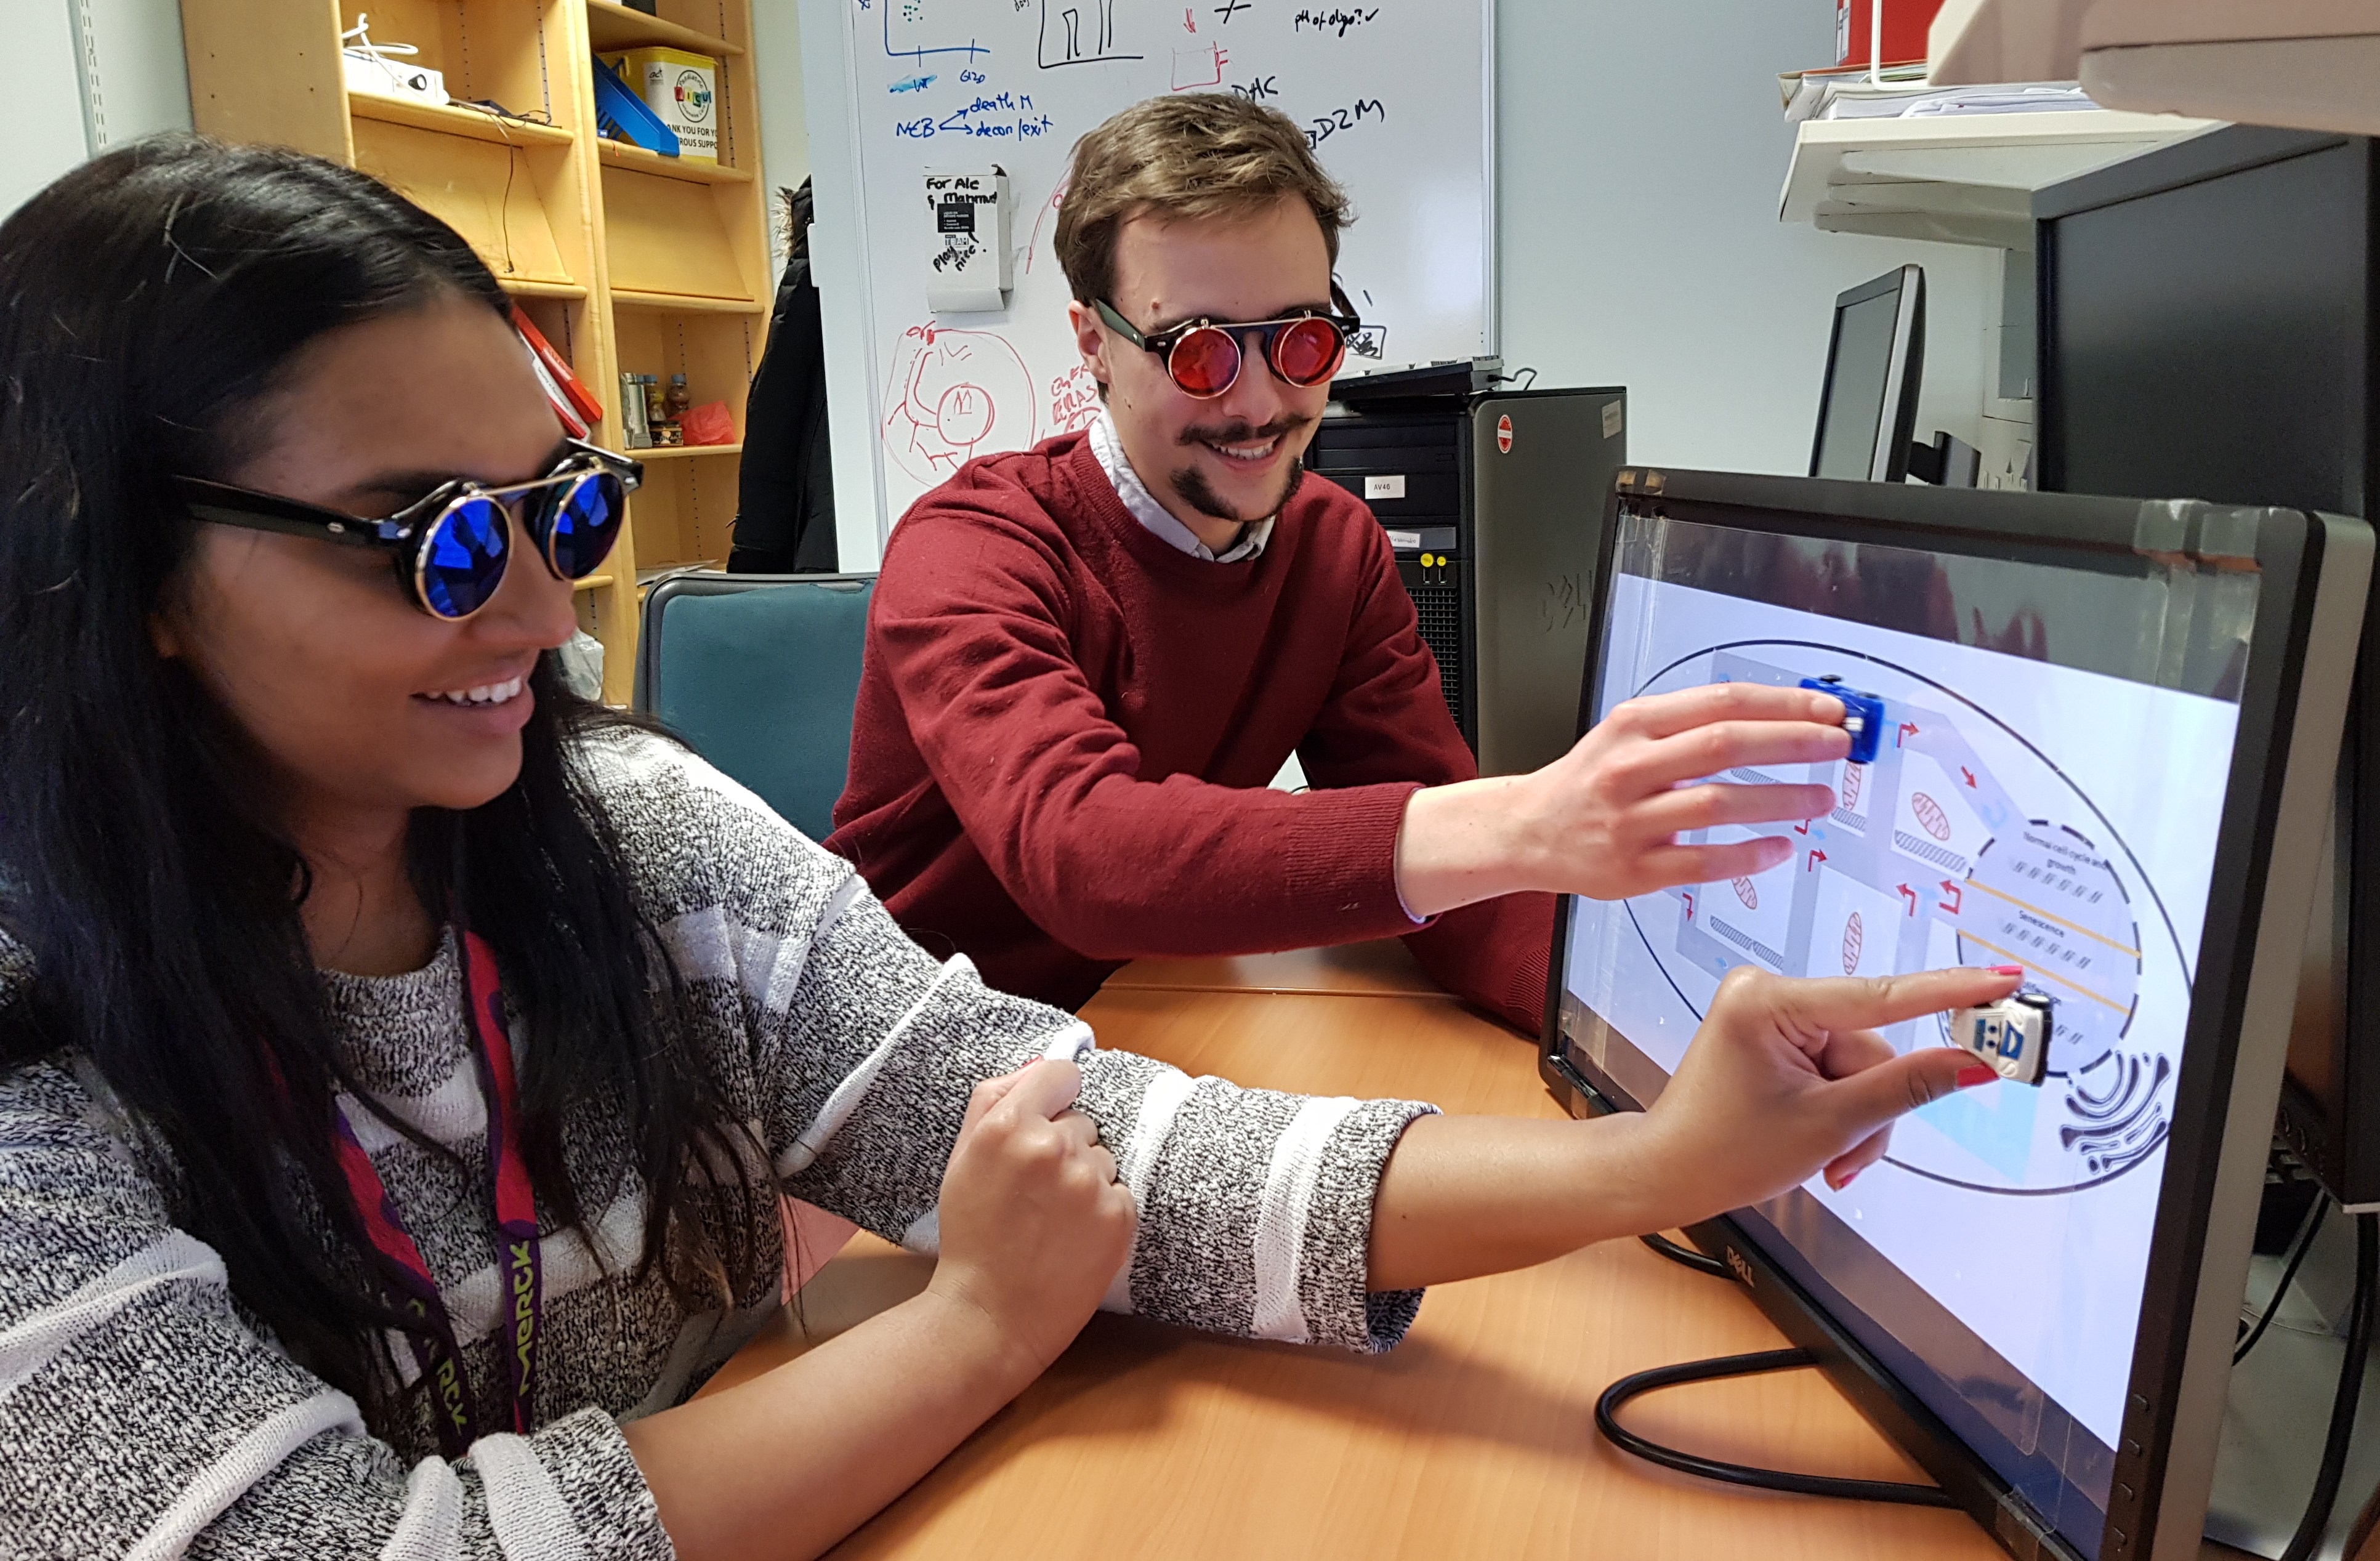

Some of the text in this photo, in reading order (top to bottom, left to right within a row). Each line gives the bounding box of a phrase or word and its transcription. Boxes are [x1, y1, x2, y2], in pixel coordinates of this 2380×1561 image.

[969, 92, 1015, 112] death
[682, 126, 696, 135] YOU
[697, 127, 710, 137] FOR
[897, 118, 935, 138] NEB
[679, 137, 696, 147] ROUS
[927, 178, 951, 190] For
[2019, 910, 2064, 938] Senescence
